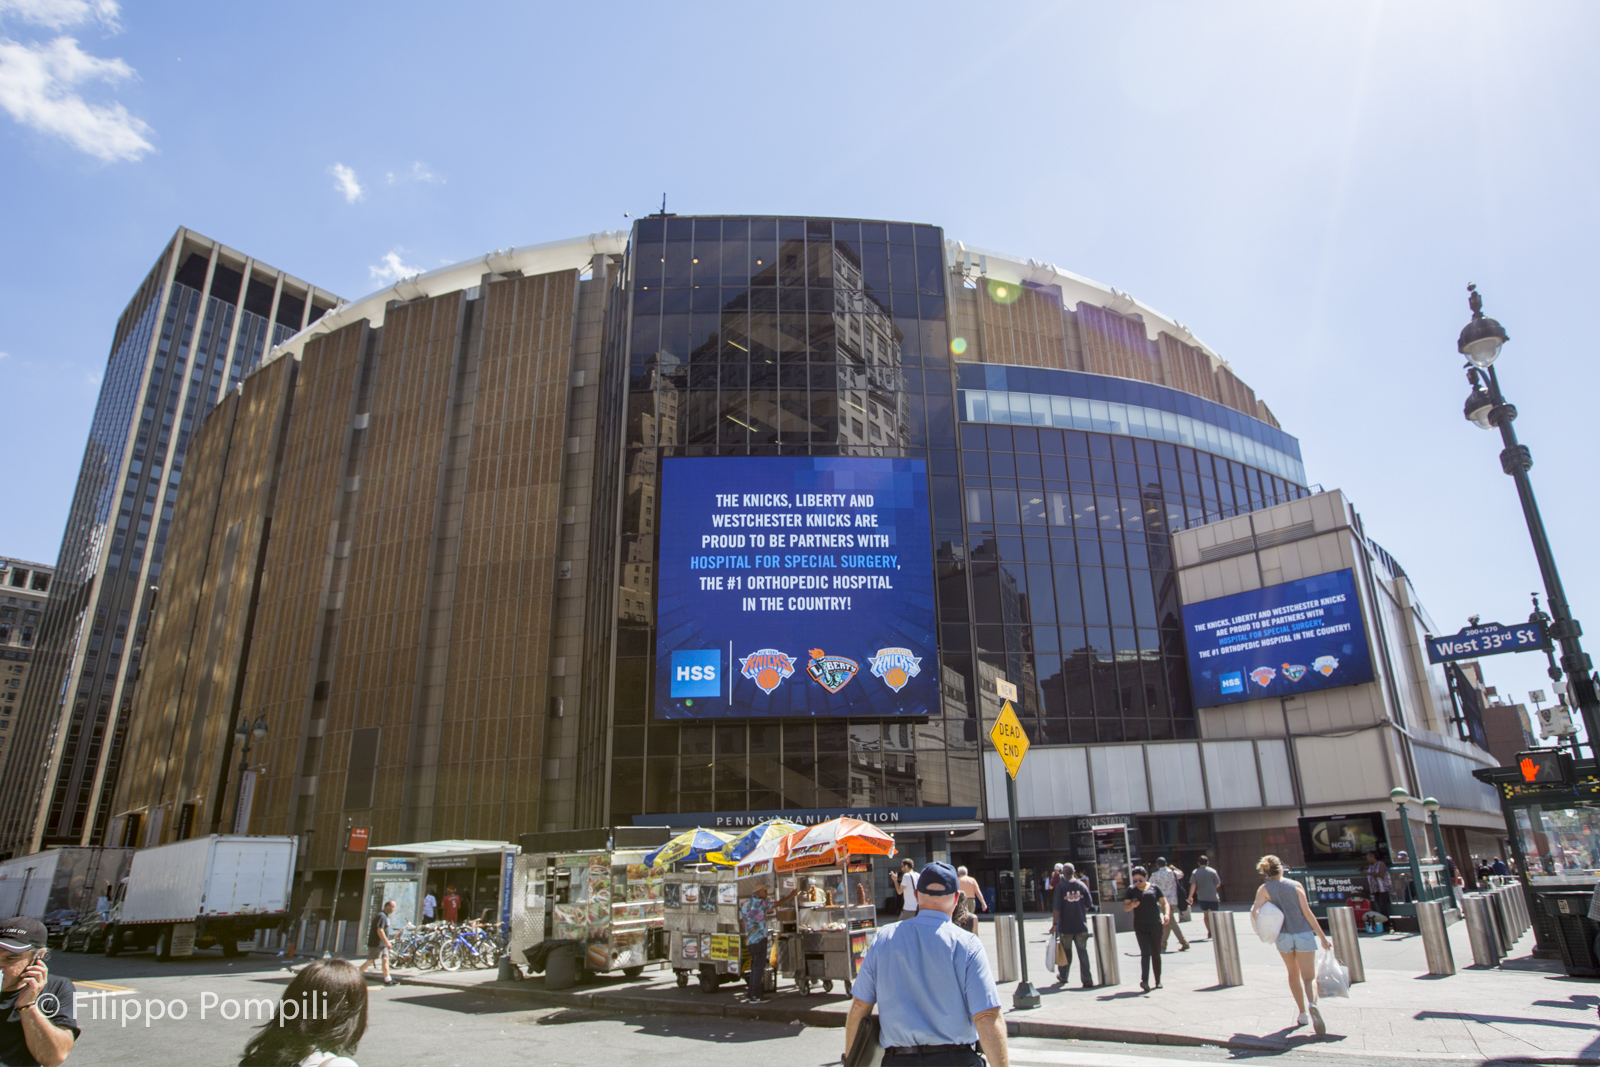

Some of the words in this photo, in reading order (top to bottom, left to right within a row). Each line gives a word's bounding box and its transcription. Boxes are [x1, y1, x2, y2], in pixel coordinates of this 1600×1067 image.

[716, 494, 739, 506] THE
[743, 494, 792, 509] KNICKS,
[796, 494, 846, 507] LIBERTY
[850, 495, 874, 507] AND
[712, 514, 802, 527] WESTCHESTER
[806, 514, 851, 527] KNICKS
[855, 515, 878, 527] ARE
[702, 535, 745, 548] PROUD
[750, 535, 765, 548] TO
[770, 535, 785, 548] BE
[790, 534, 854, 547] PARTNERS
[857, 534, 889, 547] WITH
[690, 556, 751, 569] HOSPITAL
[755, 556, 780, 568] FOR
[784, 555, 837, 568] SPECIAL
[841, 555, 900, 570] SURGERY,
[700, 577, 723, 590] THE
[727, 577, 742, 590] #1
[747, 576, 828, 590] ORTHOPEDIC
[833, 576, 892, 589] HOSPITAL
[743, 598, 755, 611] IN
[760, 598, 784, 611] THE
[788, 597, 851, 610] COUNTRY!
[1207, 619, 1231, 629] KNICKS,
[1232, 613, 1257, 624] LIBERTY
[1258, 611, 1271, 619] AND
[1272, 600, 1319, 616] WESTCHESTER
[1320, 594, 1346, 606] KNICKS
[1229, 625, 1251, 634] PROUD
[1272, 613, 1305, 627] PARTNERS
[1306, 609, 1324, 619] WITH
[1219, 634, 1248, 645] HOSPITAL
[1250, 631, 1262, 639] FOR
[1264, 626, 1290, 637] SPECIAL
[1221, 642, 1260, 654] ORTHOPEDIC
[1261, 636, 1292, 647] HOSPITAL
[1302, 630, 1315, 639] THE
[1316, 623, 1351, 636] COUNTRY!
[1436, 639, 1479, 656] West
[1481, 631, 1512, 649] 33rd
[1516, 630, 1536, 643] St
[744, 654, 792, 674] KNICKS
[873, 655, 916, 671] KNICKS
[677, 666, 715, 680] HSS
[1001, 684, 1012, 696] NEW
[1222, 678, 1240, 687] HSS
[999, 723, 1020, 738] DEAD
[1004, 743, 1019, 757] END
[383, 862, 407, 871] Parking
[737, 862, 750, 877] NUTS
[754, 860, 769, 872] NUTS
